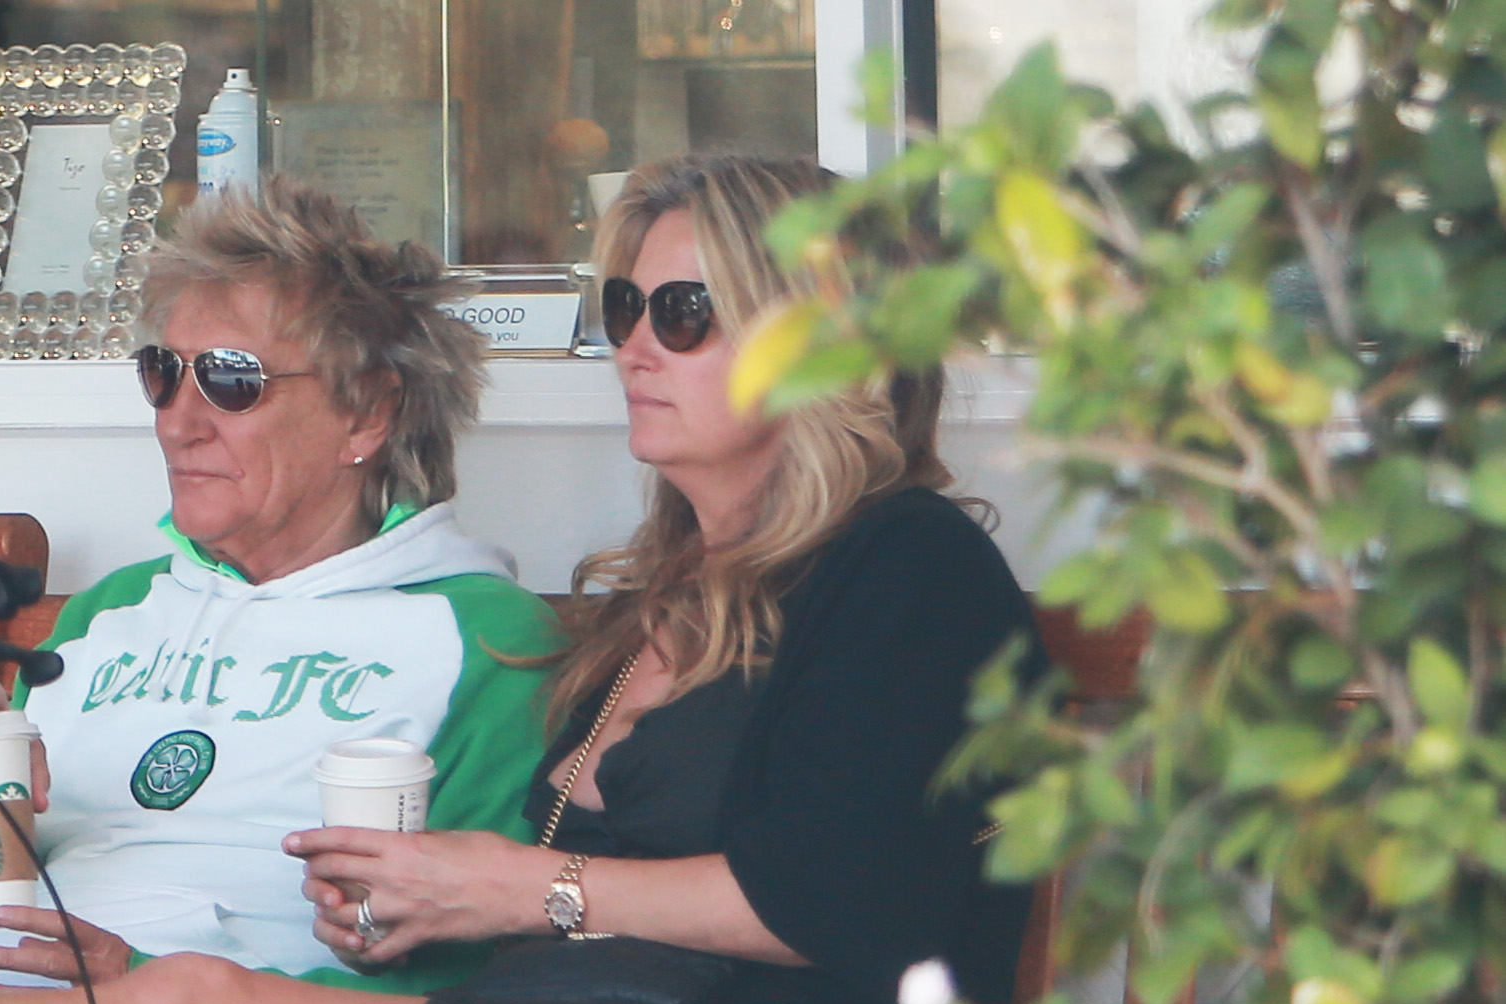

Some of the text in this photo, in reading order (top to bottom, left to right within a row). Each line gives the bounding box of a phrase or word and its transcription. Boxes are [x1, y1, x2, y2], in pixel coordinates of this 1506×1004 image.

[462, 307, 525, 324] GOOD
[496, 332, 519, 343] you
[232, 651, 395, 722] FC
